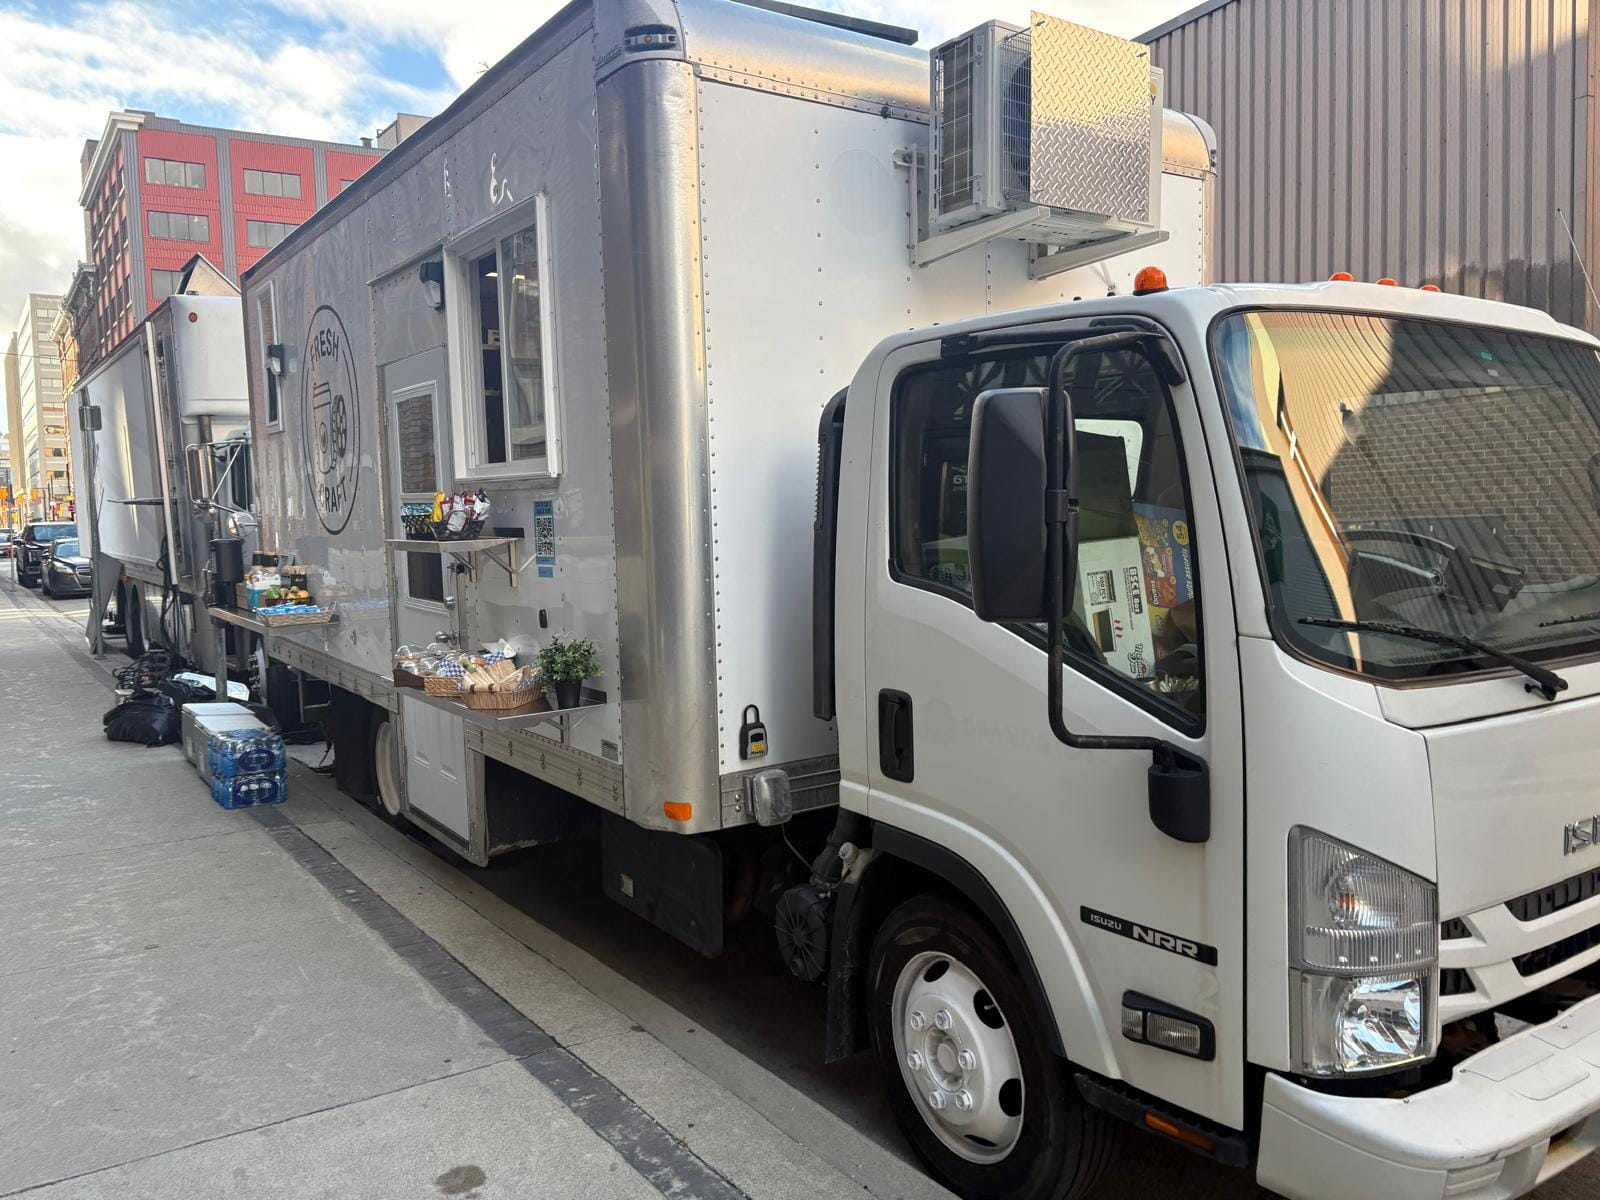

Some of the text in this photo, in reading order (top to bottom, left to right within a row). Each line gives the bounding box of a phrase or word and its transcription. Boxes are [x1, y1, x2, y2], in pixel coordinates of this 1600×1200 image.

[310, 328, 340, 371] FRESH
[319, 475, 347, 513] CRAFT
[1175, 525, 1185, 540] 54
[1090, 914, 1198, 959] ISUZU NRR
